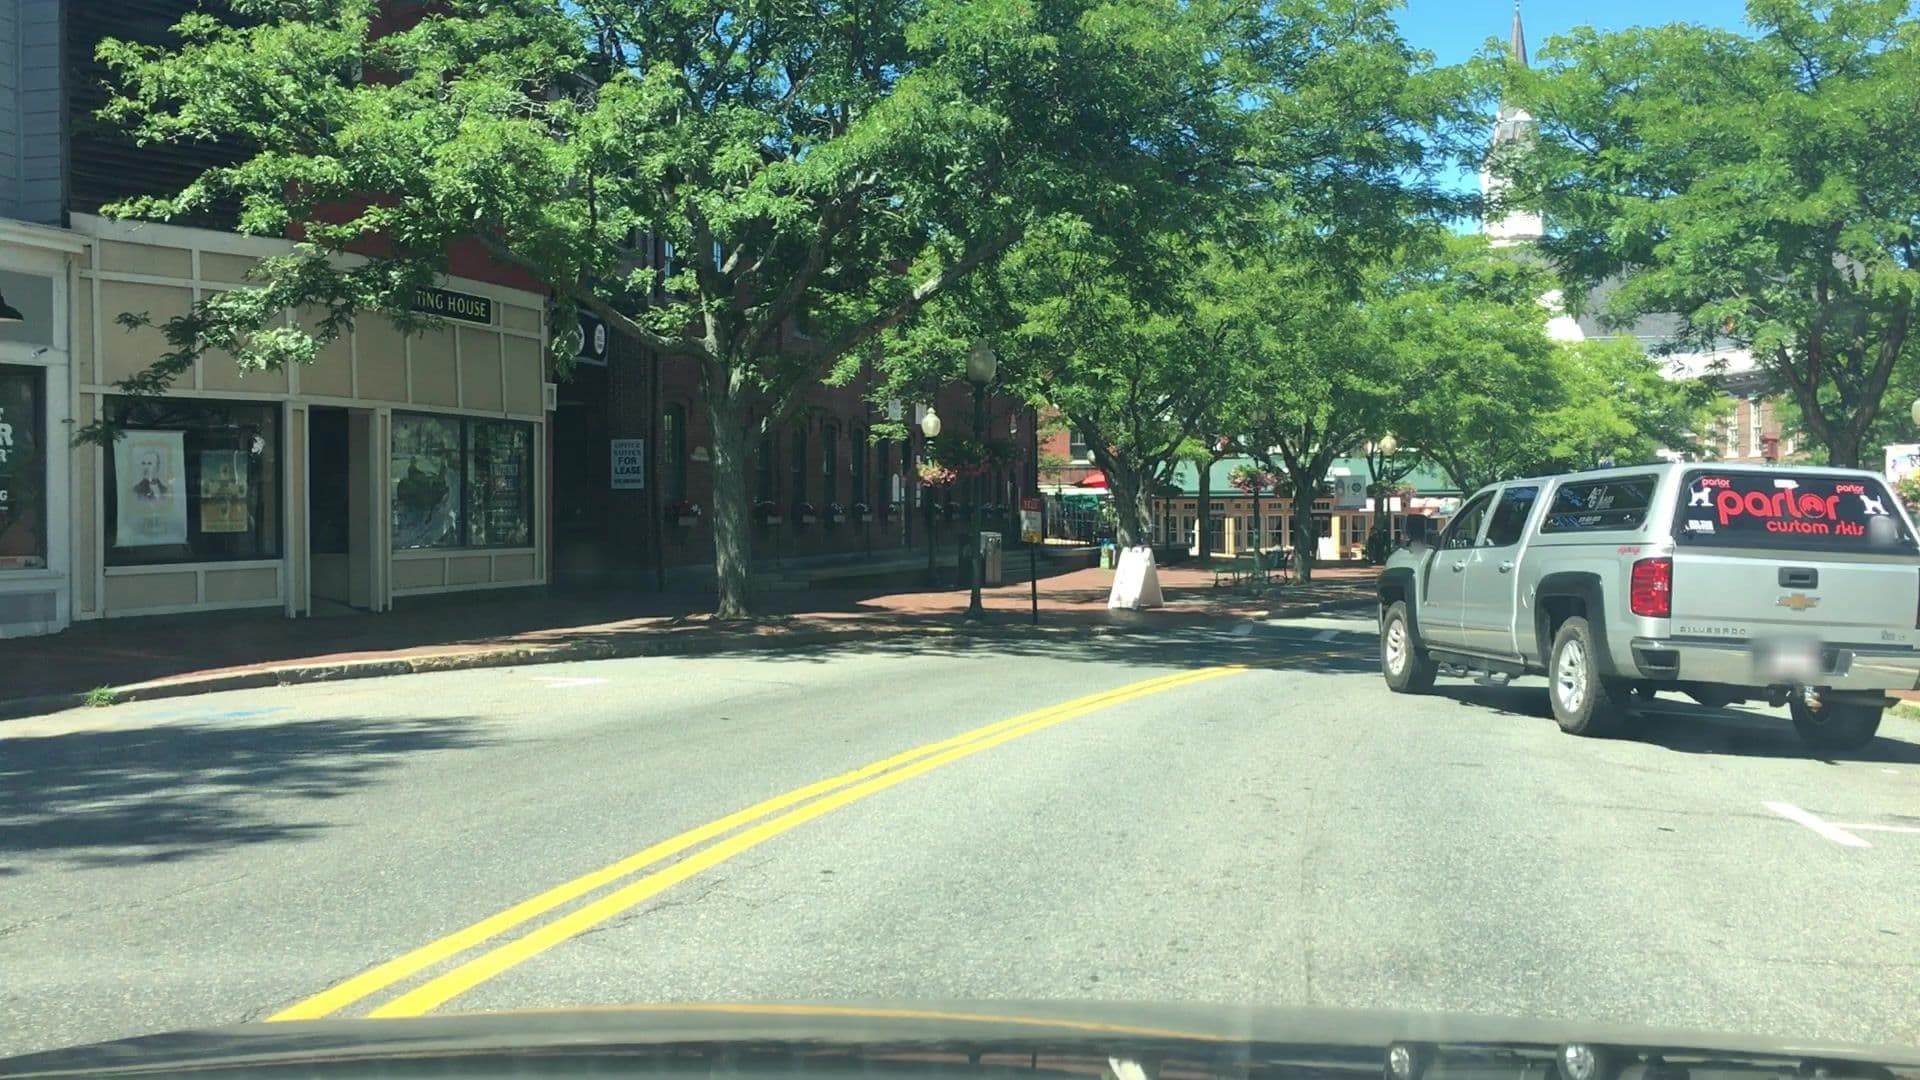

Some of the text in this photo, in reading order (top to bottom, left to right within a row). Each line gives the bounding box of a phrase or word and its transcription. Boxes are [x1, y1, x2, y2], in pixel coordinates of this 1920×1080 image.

[447, 296, 486, 317] HOUSE
[617, 456, 637, 465] FOR
[614, 466, 641, 475] LEASE
[1716, 487, 1839, 525] parlor
[1766, 519, 1865, 536] custom skis
[1679, 625, 1746, 635] SILVERADO
